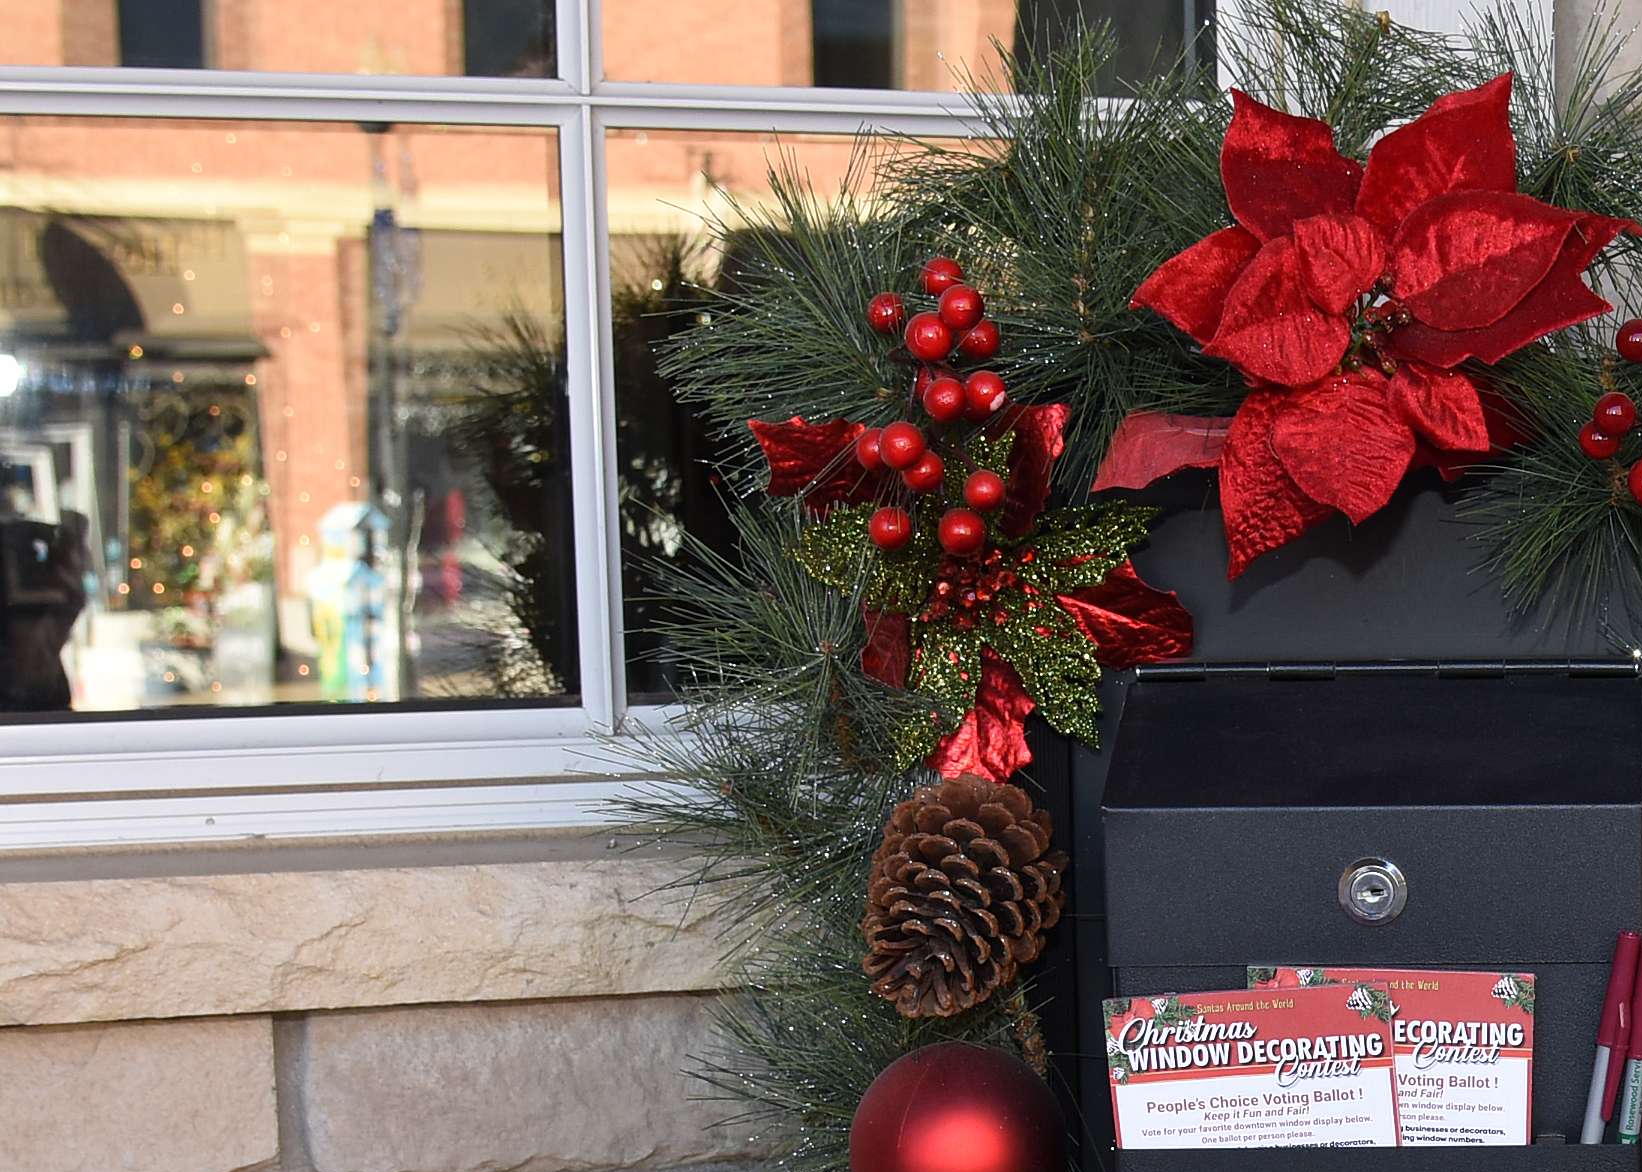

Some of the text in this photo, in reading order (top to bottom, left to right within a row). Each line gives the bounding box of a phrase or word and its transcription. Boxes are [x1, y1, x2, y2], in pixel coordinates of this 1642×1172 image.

[1417, 980, 1440, 991] World
[1196, 998, 1294, 1014] Santas Around the World
[1118, 1015, 1258, 1053] Christmas
[1394, 1020, 1524, 1047] ECORATING
[1128, 1033, 1383, 1072] WINDOW DECORATING
[1414, 1038, 1500, 1069] Contest
[1274, 1054, 1361, 1087] Contest
[1398, 1073, 1499, 1089] Voting Ballot !
[1210, 1094, 1259, 1109] Choice
[1263, 1091, 1309, 1106] Voting
[1313, 1089, 1355, 1102] Ballot
[1359, 1088, 1364, 1100] !
[1398, 1089, 1444, 1098] and Fair!
[1625, 1061, 1641, 1130] Rosewood Servi
[1204, 1106, 1310, 1122] Keep it Fun and Fair!
[1411, 1101, 1443, 1110] window
[1445, 1102, 1476, 1112] display
[1141, 1128, 1161, 1137] Vote
[1163, 1127, 1176, 1136] for
[1178, 1126, 1197, 1136] your
[1199, 1123, 1232, 1133] favorite
[1234, 1120, 1277, 1130] downtown
[1279, 1117, 1311, 1127] window
[1313, 1116, 1343, 1126] display
[1405, 1125, 1449, 1133] businesses
[1201, 1136, 1217, 1144] One
[1219, 1134, 1241, 1143] ballot
[1243, 1133, 1256, 1142] per
[1258, 1132, 1285, 1141] person
